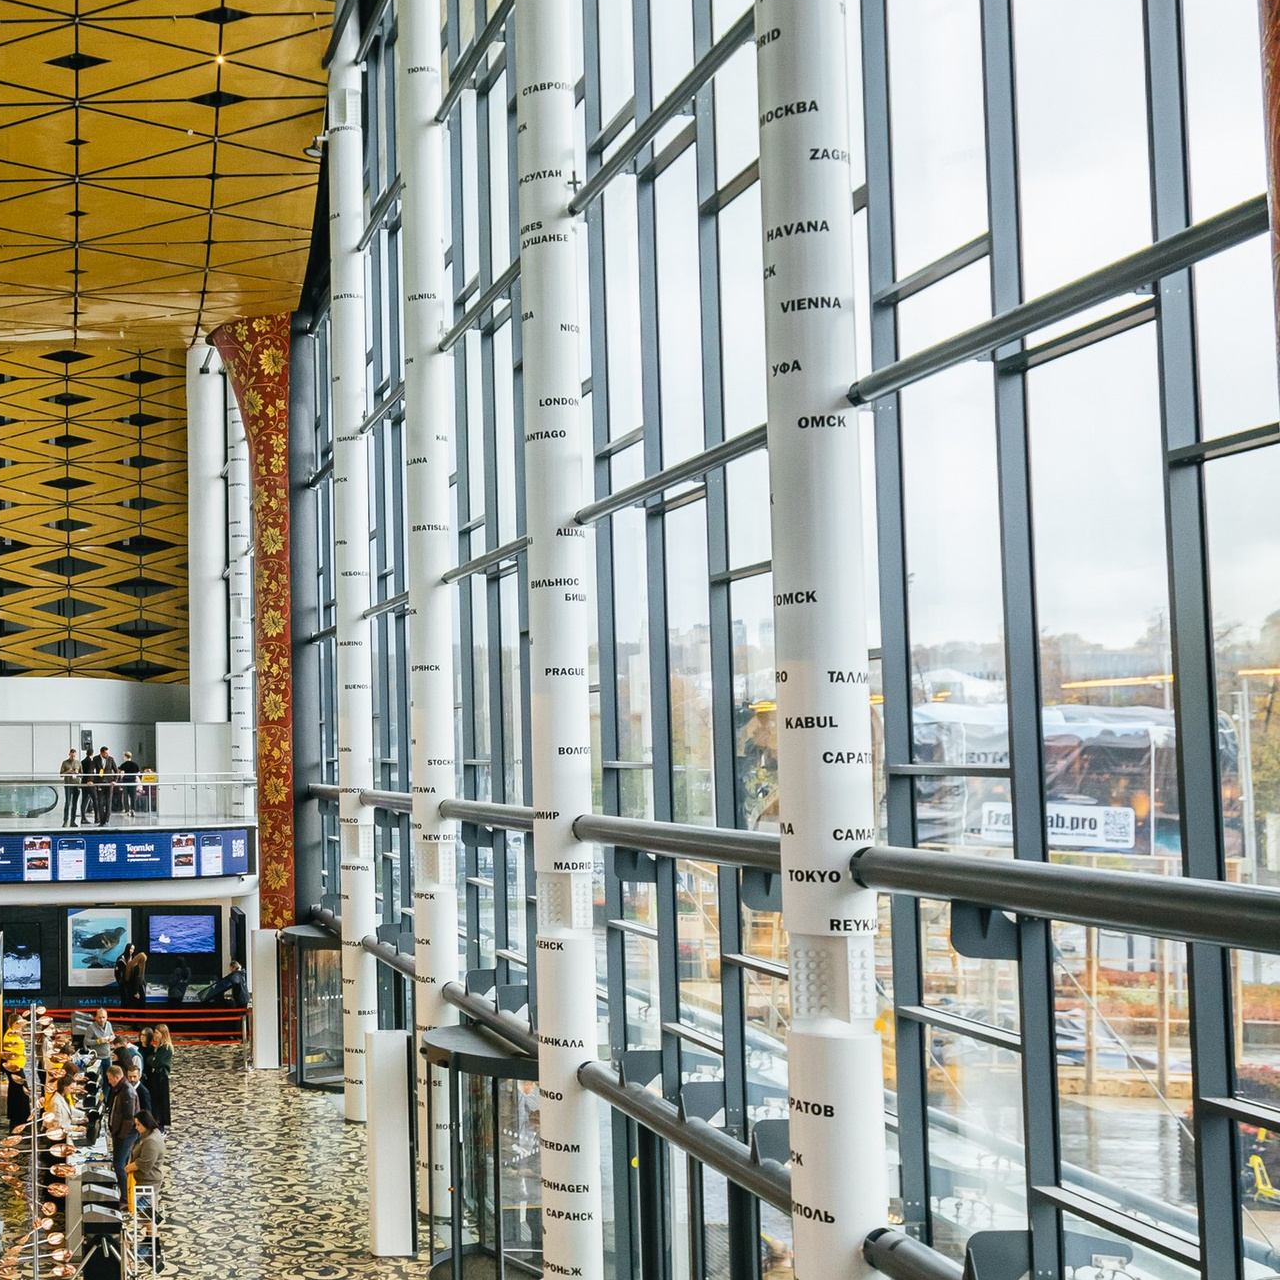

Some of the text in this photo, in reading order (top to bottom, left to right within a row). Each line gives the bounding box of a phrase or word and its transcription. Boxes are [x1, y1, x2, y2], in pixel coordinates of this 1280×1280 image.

[767, 220, 830, 243] HAVANA
[522, 233, 569, 251] ДУШАНБЕ
[407, 293, 437, 301] VILNIUS
[780, 297, 841, 313] VIENNA
[772, 360, 802, 377] УФА
[539, 397, 579, 407] LONDON
[797, 415, 847, 429] ОМСК
[531, 578, 579, 590] ВИЛЬНЮС
[412, 664, 440, 672] БРЯНСК
[545, 667, 585, 677] PRAGUE
[785, 716, 838, 729] KABUL
[554, 862, 591, 871] MADRID
[789, 870, 841, 883] TOKYO
[789, 1096, 835, 1118] РАТОВ
[546, 1208, 593, 1221] САРАНСК
